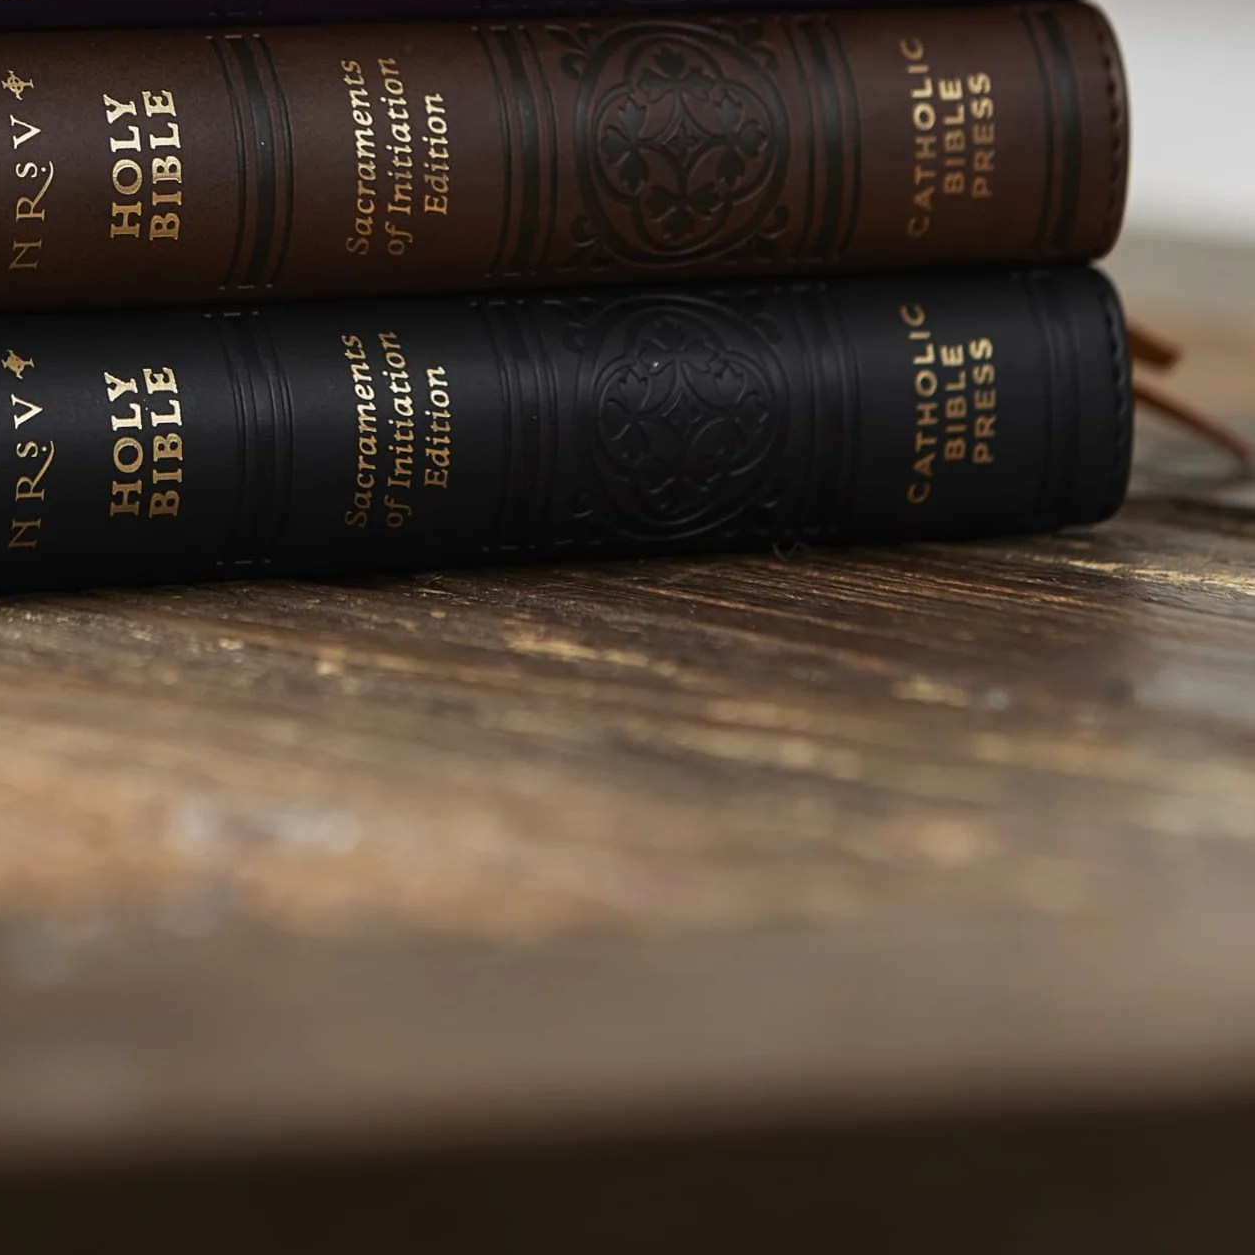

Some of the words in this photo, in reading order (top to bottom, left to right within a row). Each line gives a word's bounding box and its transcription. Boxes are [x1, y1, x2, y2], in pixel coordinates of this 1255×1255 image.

[102, 93, 143, 239] HOLY
[142, 89, 182, 241] BIBLE
[340, 59, 377, 256] Sacraments
[377, 56, 414, 216] Initiation
[423, 93, 451, 216] Edition
[900, 37, 937, 239] CATHOLIC
[938, 77, 966, 195] BIBLE
[967, 70, 996, 199] PRESS
[386, 222, 413, 257] of
[103, 371, 144, 517] HOLY
[142, 366, 183, 519] BIBLE
[341, 333, 377, 530] Sacraments
[378, 331, 414, 490] Initiation
[423, 366, 451, 490] Edition
[900, 303, 939, 505] CATHOLIC
[941, 343, 967, 462] BIBLE
[968, 337, 997, 465] PRESS
[385, 495, 412, 530] of
